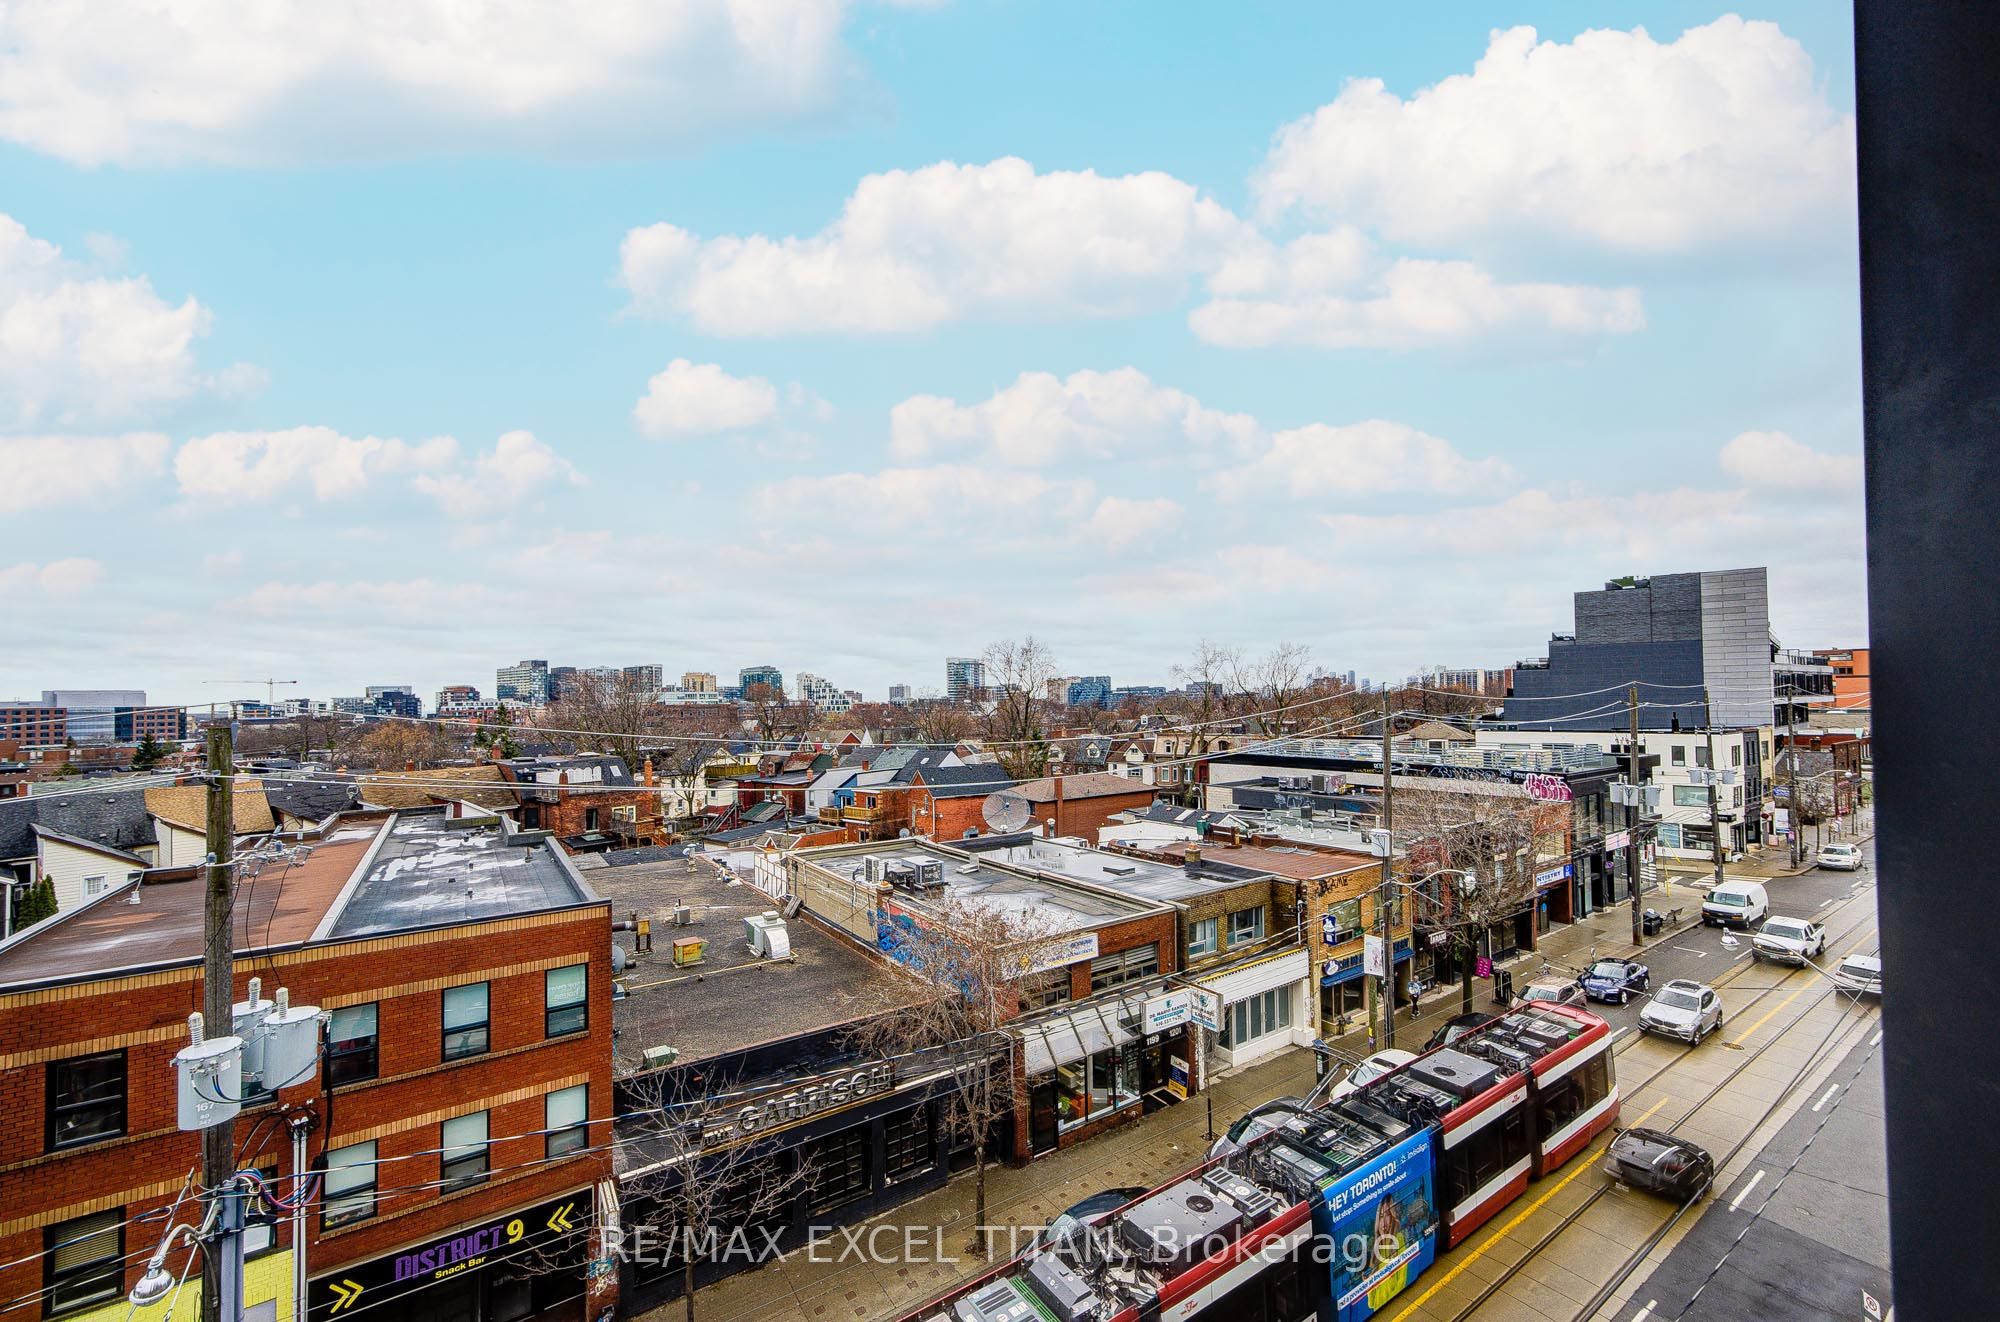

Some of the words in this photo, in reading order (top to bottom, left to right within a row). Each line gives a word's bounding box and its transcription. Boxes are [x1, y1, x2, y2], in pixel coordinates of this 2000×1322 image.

[1171, 1003, 1188, 1012] SANTOS
[1146, 1034, 1160, 1046] 1199
[1169, 1027, 1182, 1038] 1201
[195, 1101, 215, 1113] 167
[738, 1064, 893, 1130] GARRISON
[1328, 1190, 1349, 1212] HEY
[1350, 1160, 1397, 1199] TORONTO!
[1353, 1191, 1378, 1211] Something
[1394, 1171, 1407, 1185] about
[394, 1224, 504, 1281] DISTRICT
[507, 1219, 525, 1244] 9
[435, 1262, 466, 1279] Snack
[468, 1255, 487, 1271] Bar
